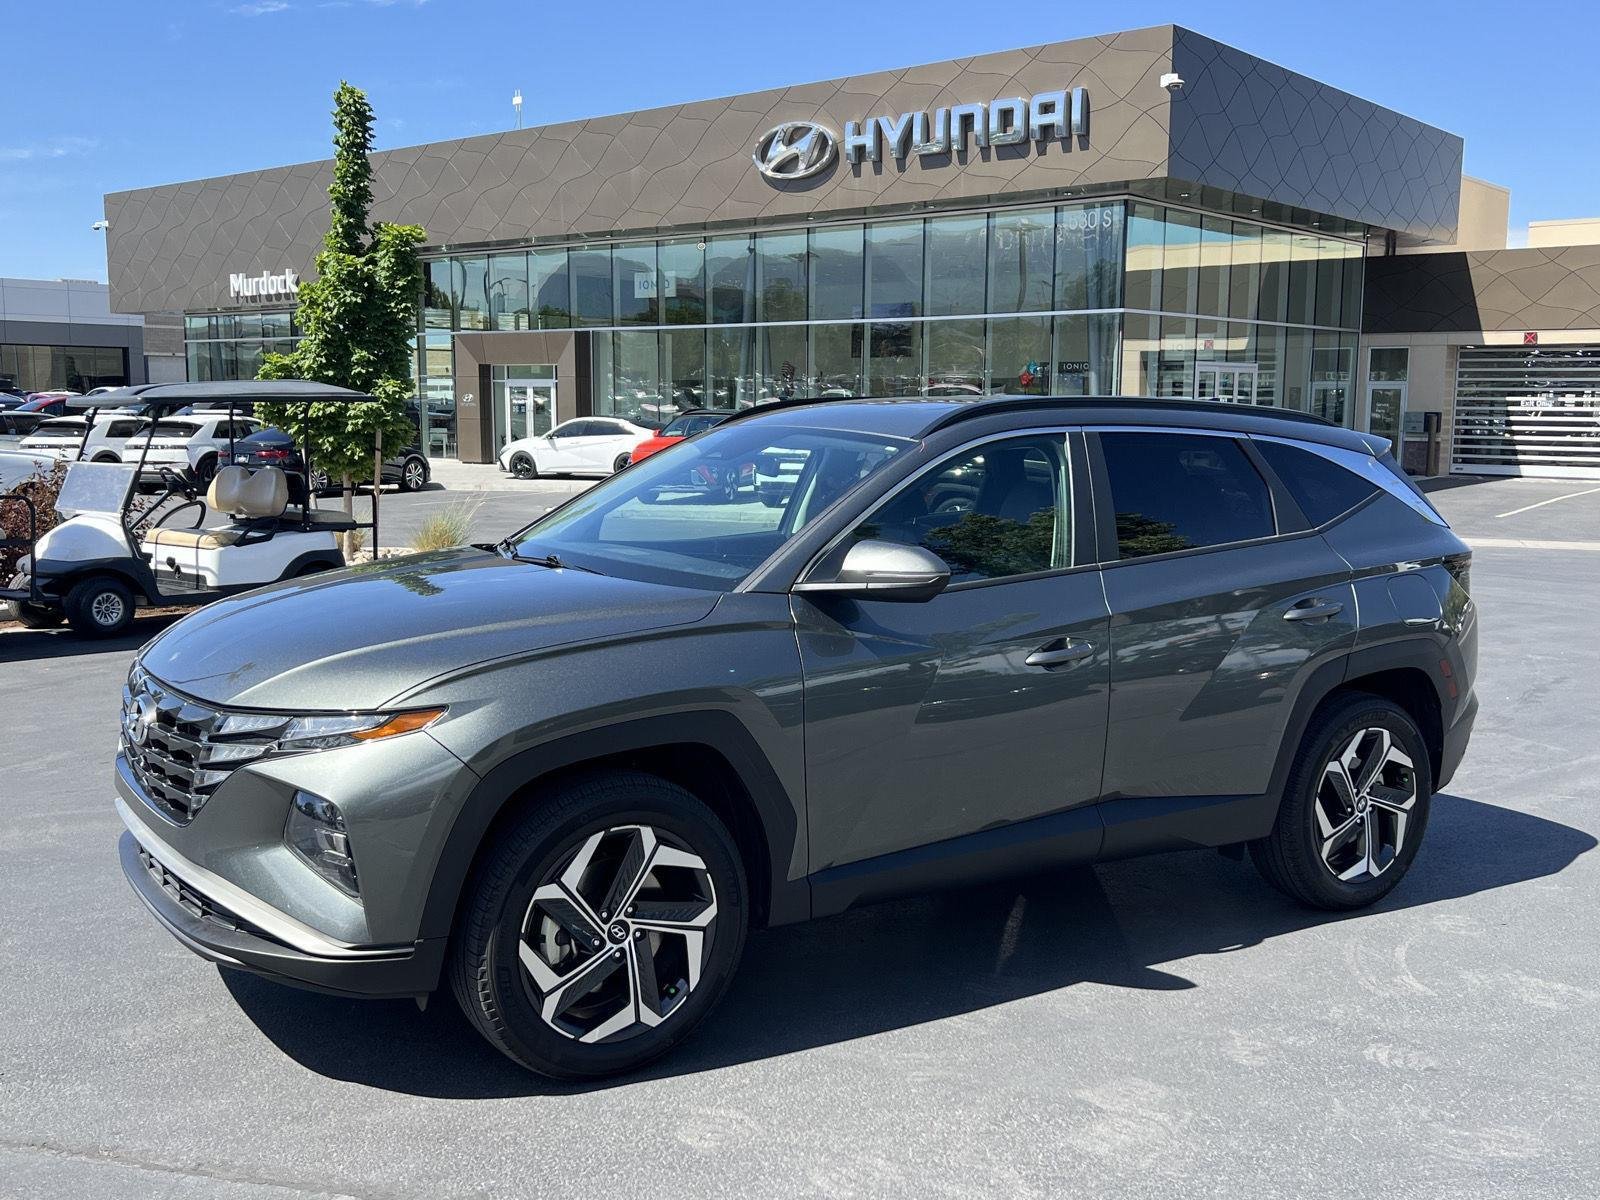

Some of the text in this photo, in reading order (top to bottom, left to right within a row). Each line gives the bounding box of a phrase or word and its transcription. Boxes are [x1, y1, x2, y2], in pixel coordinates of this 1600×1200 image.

[844, 87, 1088, 165] HYUNDAI
[1102, 209, 1112, 228] S
[229, 268, 299, 298] Murdock
[639, 279, 670, 290] IONQ
